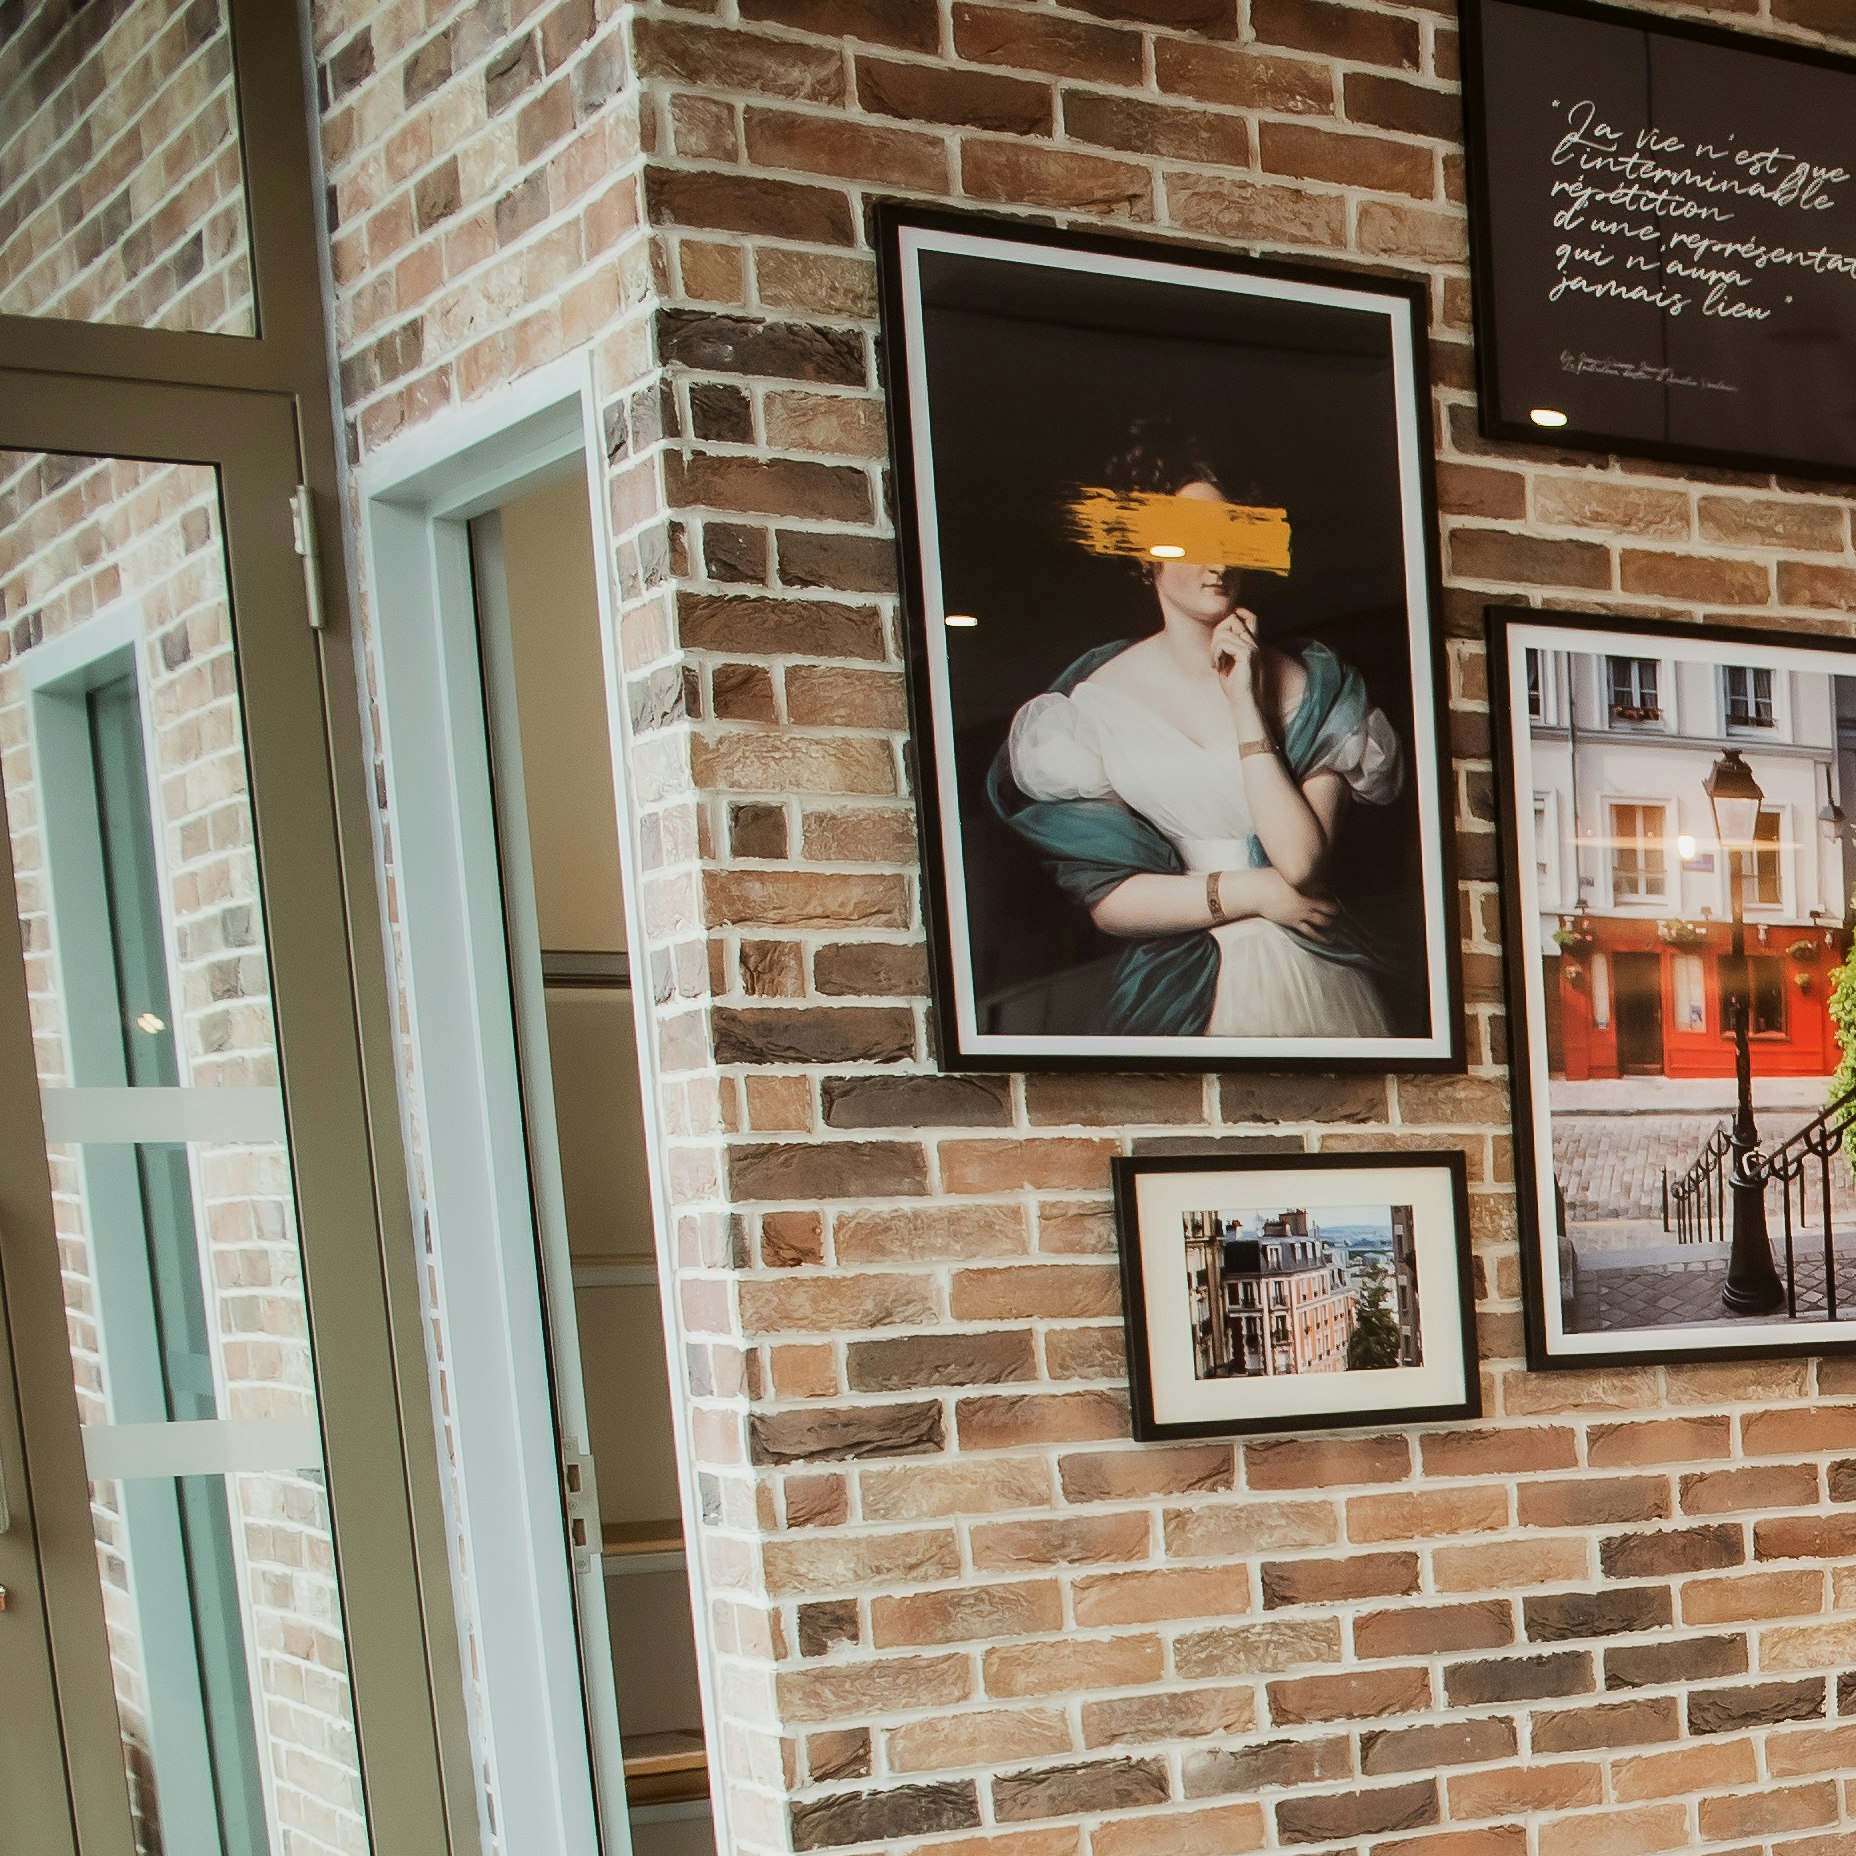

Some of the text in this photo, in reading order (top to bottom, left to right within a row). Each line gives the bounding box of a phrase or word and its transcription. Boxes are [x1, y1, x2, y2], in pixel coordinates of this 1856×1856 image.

[1636, 128, 1686, 151] vie
[1696, 133, 1796, 175] n'est
[1551, 174, 1735, 222] répétition
[1556, 244, 1752, 286] qui n'aura
[1549, 269, 1692, 316] jamais
